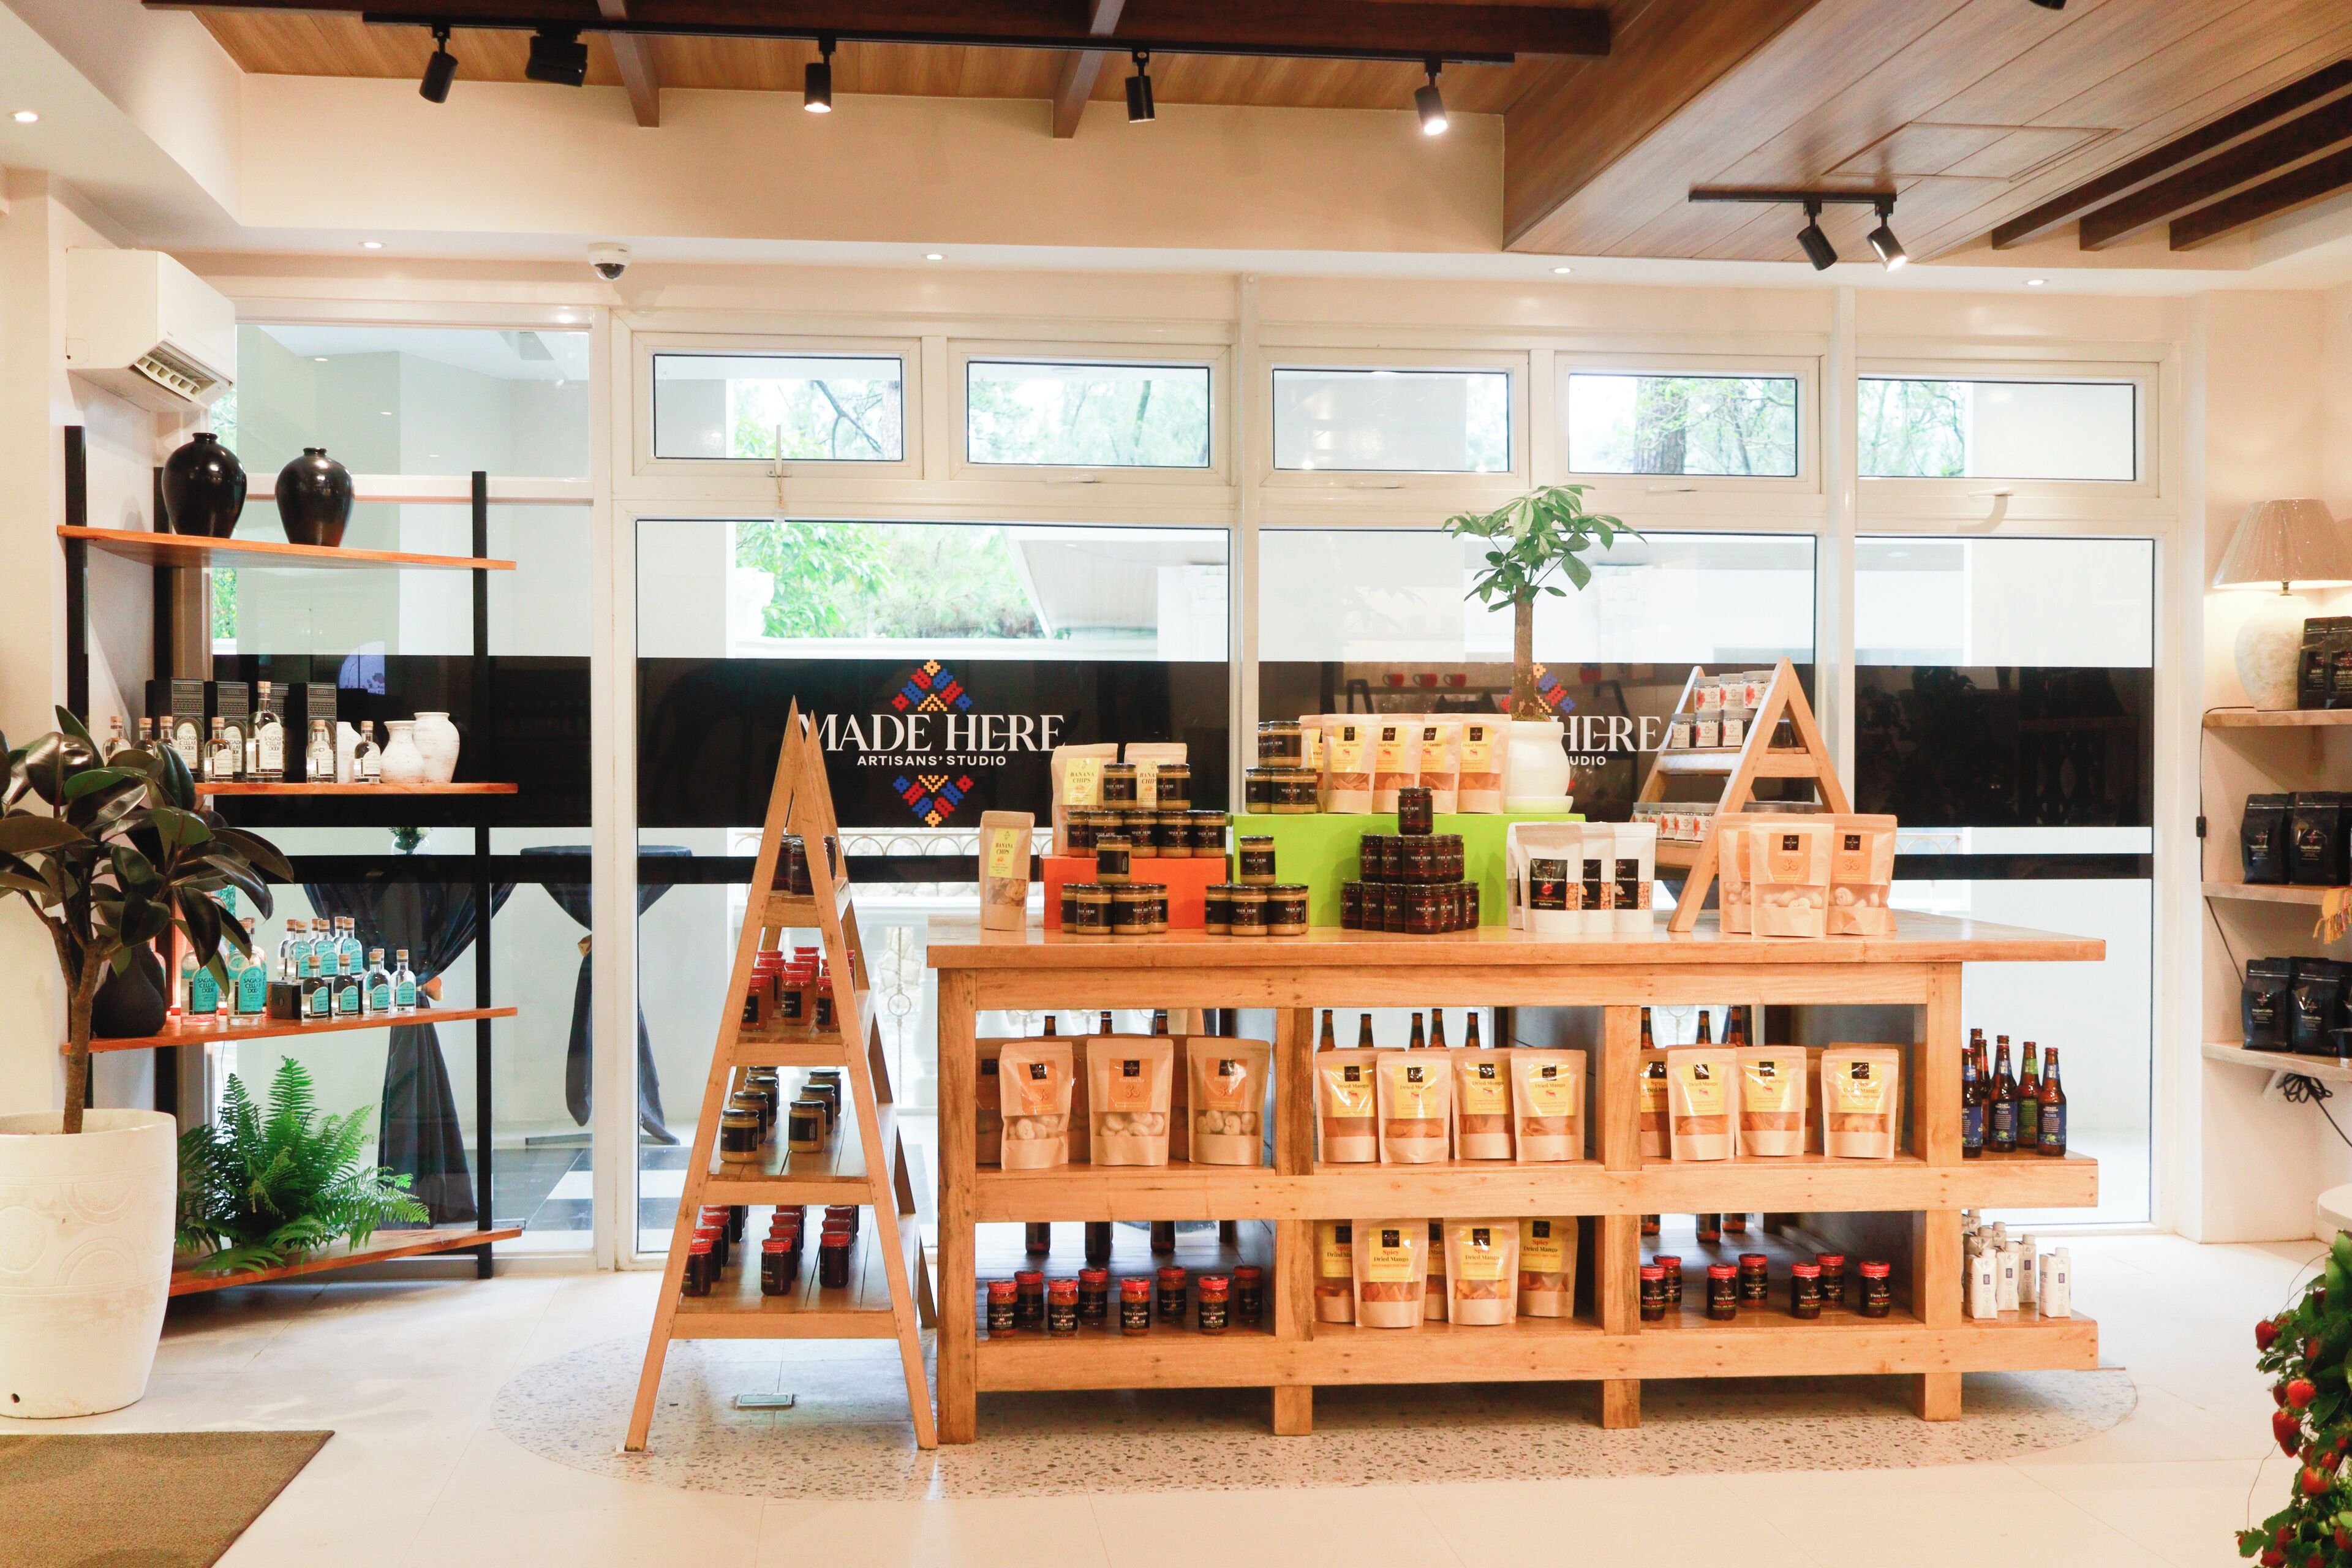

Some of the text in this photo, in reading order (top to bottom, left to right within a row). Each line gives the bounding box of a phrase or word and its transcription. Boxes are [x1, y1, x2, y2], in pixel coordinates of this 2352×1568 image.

[799, 714, 1065, 752] MADE HERE
[946, 755, 1006, 766] STUDIO
[1568, 755, 1606, 766] UDIO
